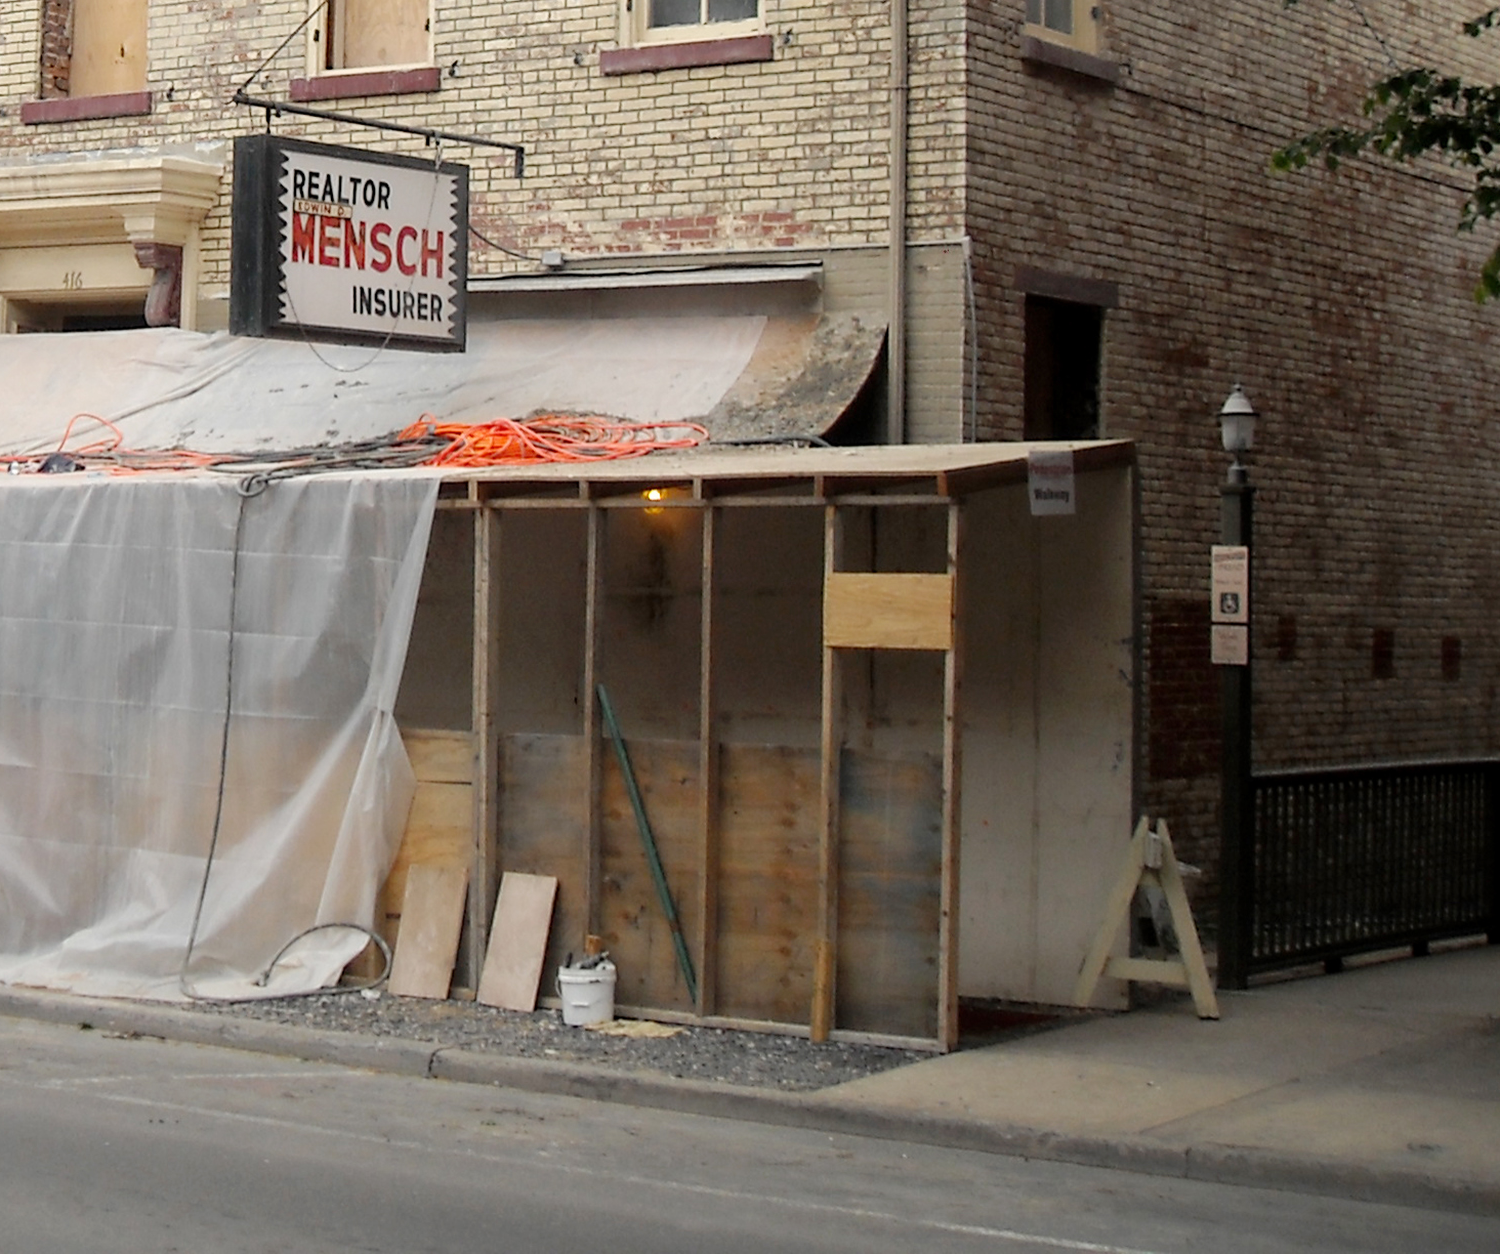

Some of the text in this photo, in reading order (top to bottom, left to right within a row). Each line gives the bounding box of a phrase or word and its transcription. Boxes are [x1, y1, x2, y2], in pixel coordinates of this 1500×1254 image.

[293, 168, 390, 210] REALTOR
[298, 201, 331, 214] EDWIN
[292, 210, 444, 279] MENSCH
[63, 271, 83, 289] 416
[352, 285, 443, 323] INSURER
